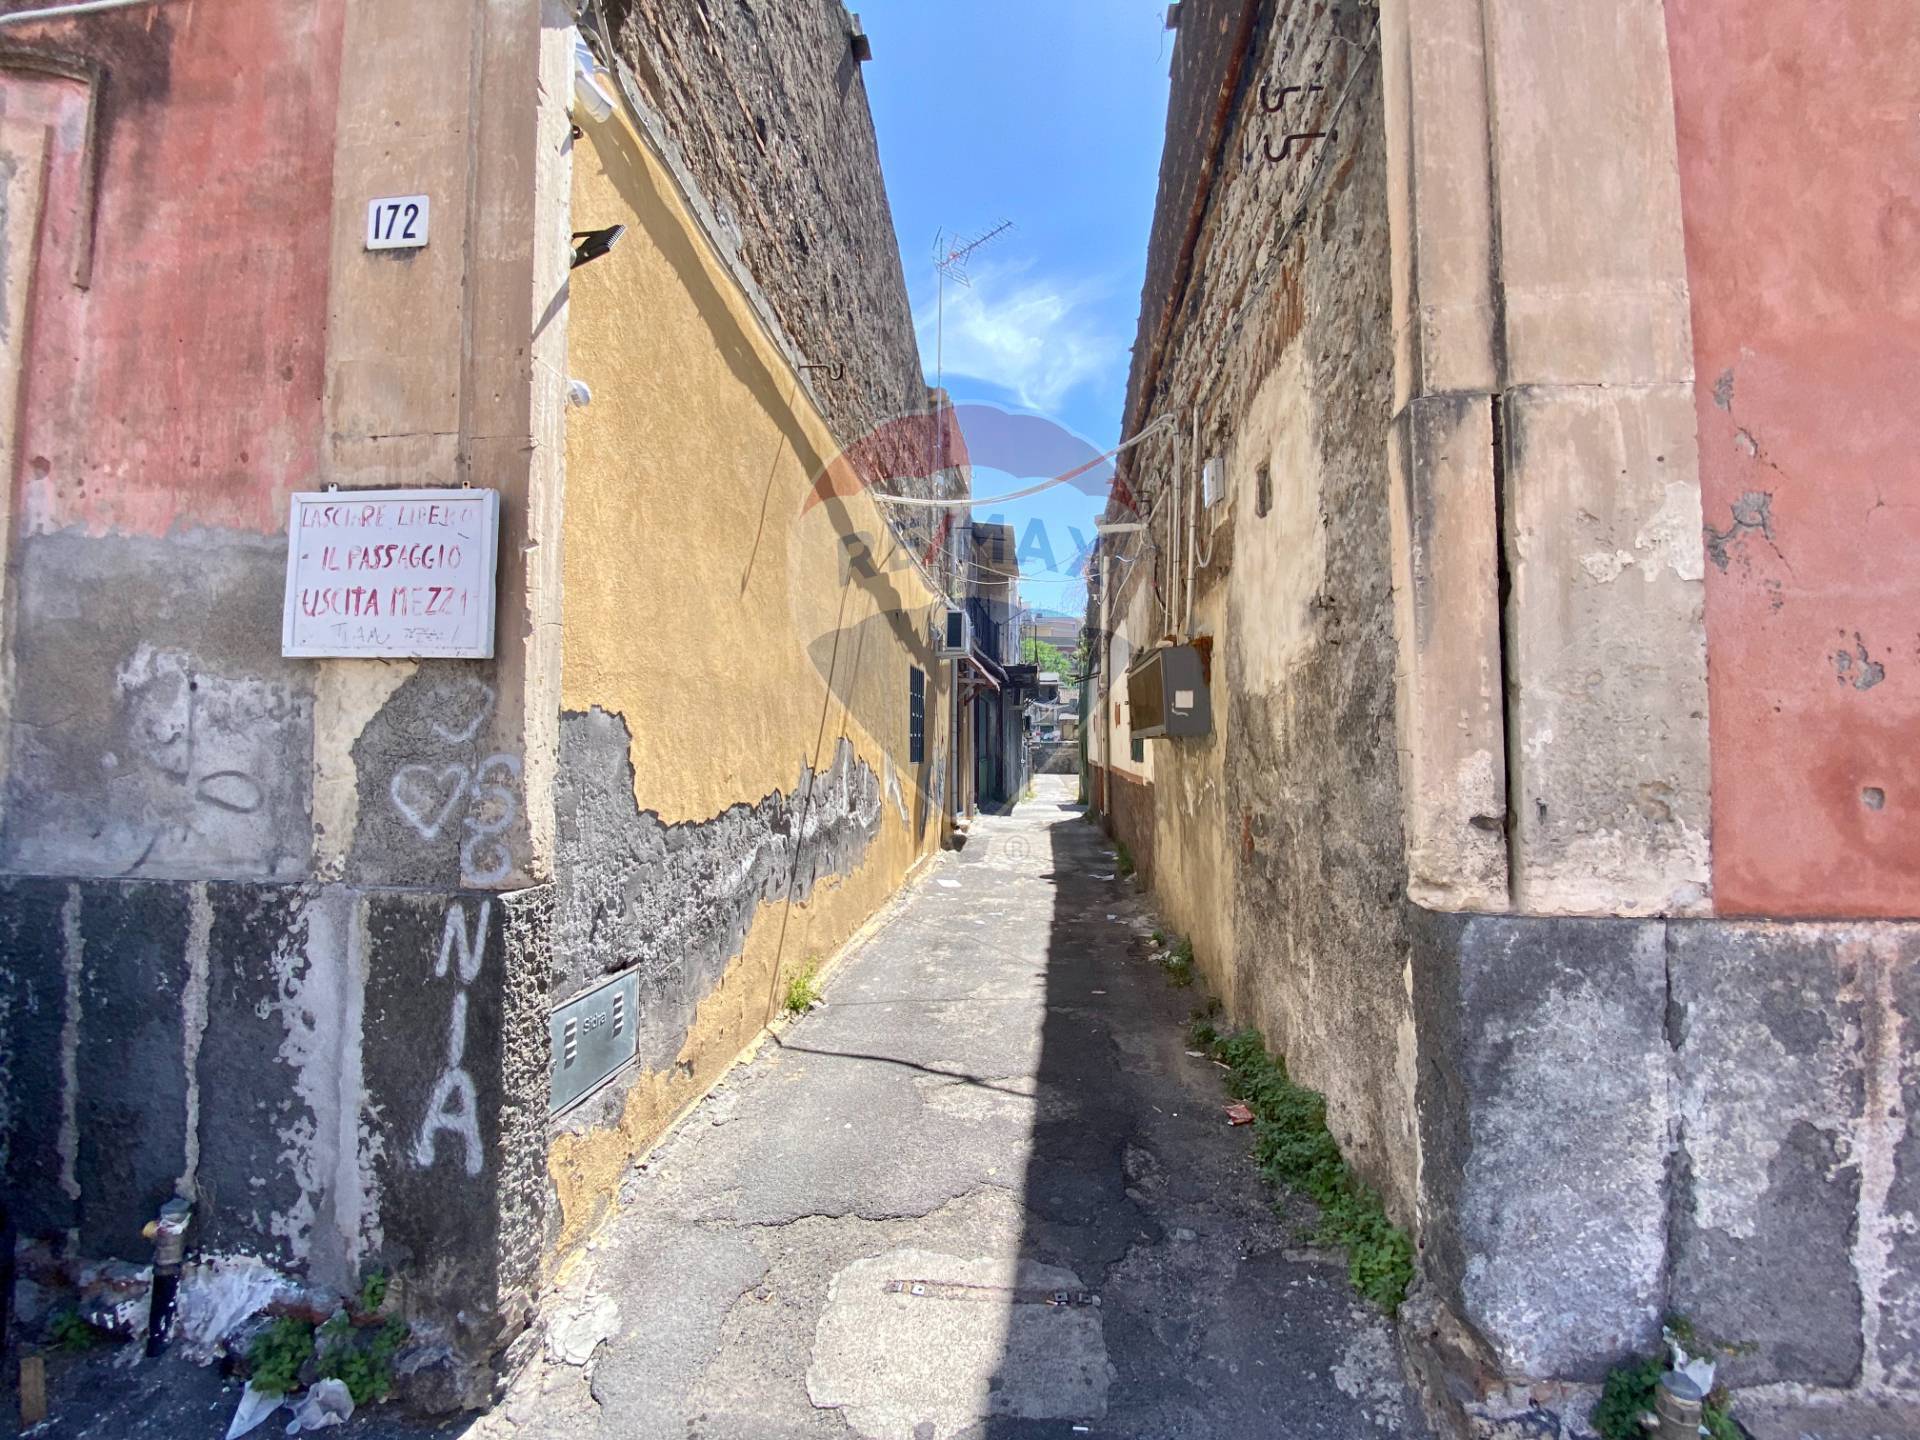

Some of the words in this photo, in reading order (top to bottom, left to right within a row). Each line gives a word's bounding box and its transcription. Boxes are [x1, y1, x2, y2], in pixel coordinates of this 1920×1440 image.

[374, 203, 419, 240] 172
[321, 546, 341, 571] IL
[347, 544, 463, 570] PASSAGGIO
[302, 586, 379, 617] USCITA
